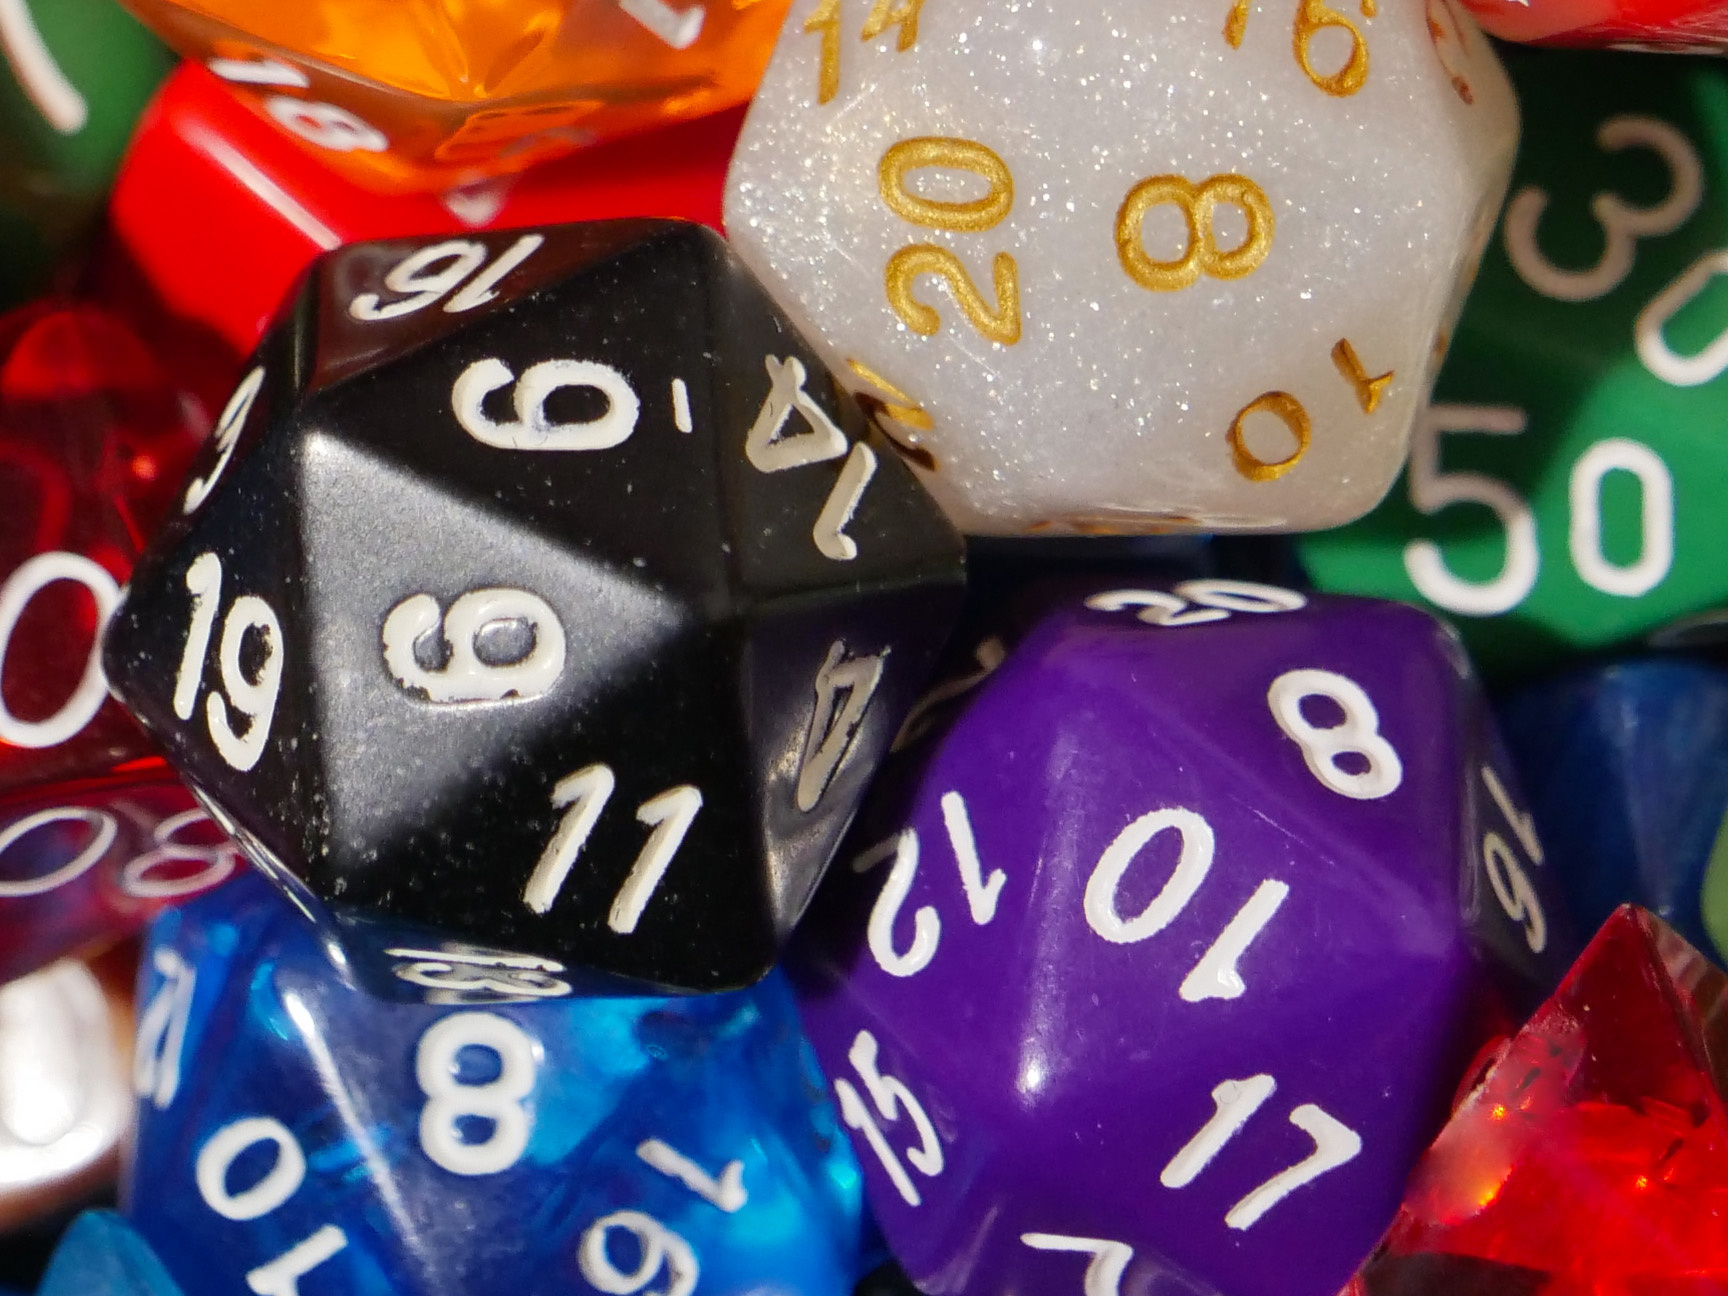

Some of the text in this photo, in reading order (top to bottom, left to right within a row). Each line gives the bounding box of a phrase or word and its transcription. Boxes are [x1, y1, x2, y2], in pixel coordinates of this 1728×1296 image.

[348, 233, 547, 324] 16
[877, 134, 1024, 348] 20
[1112, 171, 1275, 294] 8
[743, 353, 880, 562] 14
[1224, 336, 1397, 484] 10
[1406, 402, 1674, 618] 50
[171, 550, 286, 774] 19
[796, 636, 892, 814] 4
[1265, 666, 1406, 800] 8
[519, 762, 706, 936] 11
[866, 790, 1008, 979] 12
[1080, 805, 1292, 1004] 10
[1480, 764, 1548, 956] 16
[414, 1010, 548, 1178] 8
[836, 1028, 948, 1208] 15
[1158, 1072, 1365, 1232] 17
[193, 1115, 350, 1296] 10
[576, 1137, 751, 1296] 16
